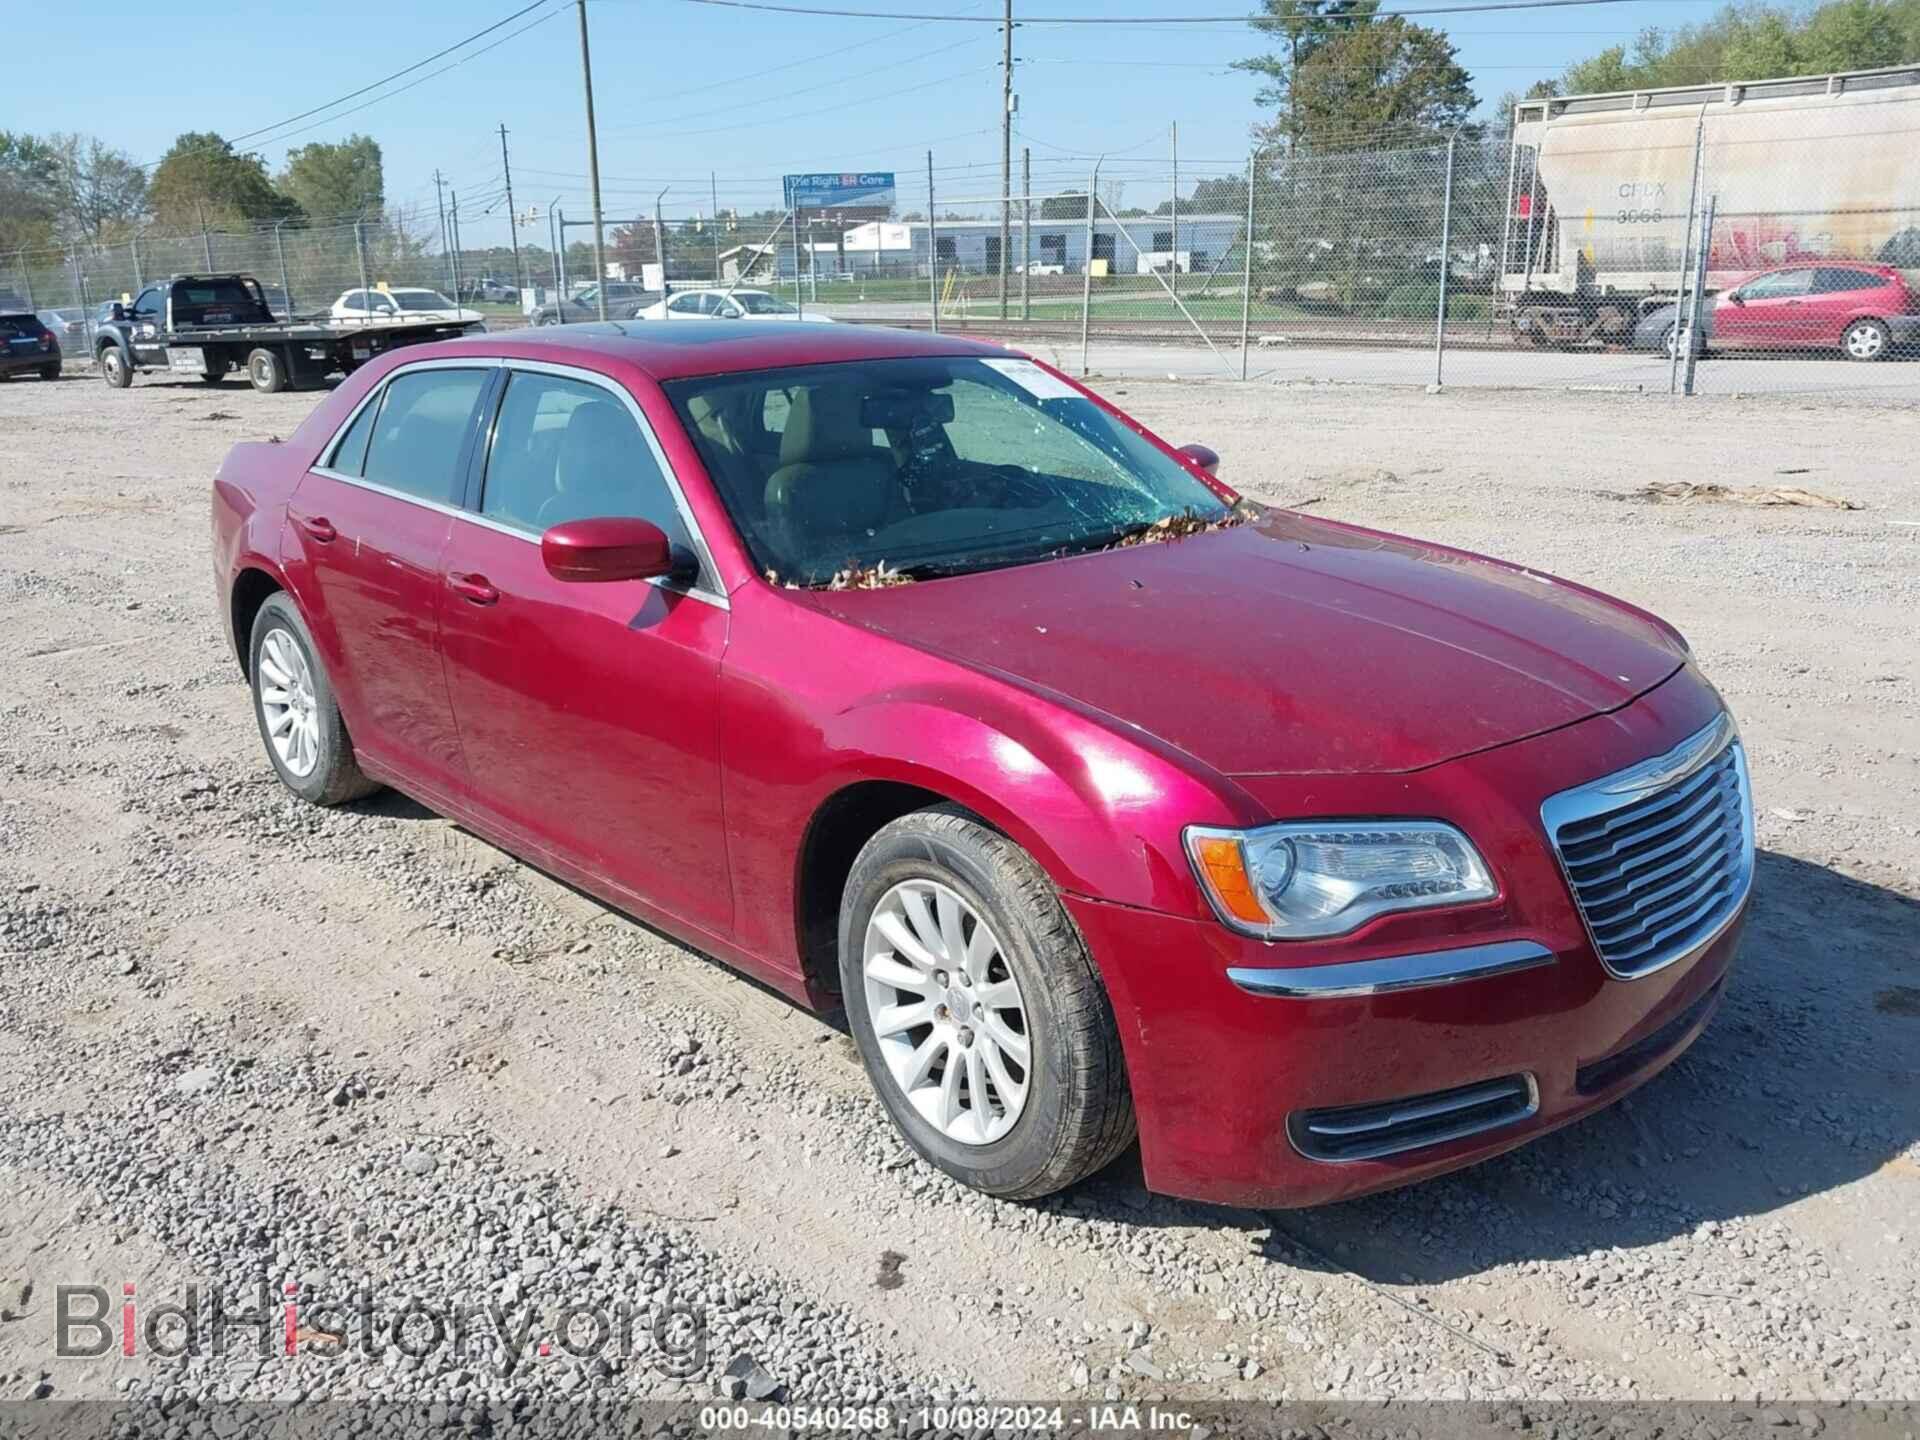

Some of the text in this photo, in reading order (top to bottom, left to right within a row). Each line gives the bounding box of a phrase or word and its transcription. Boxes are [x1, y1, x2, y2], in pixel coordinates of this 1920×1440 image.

[790, 174, 885, 188] The Right ER Care
